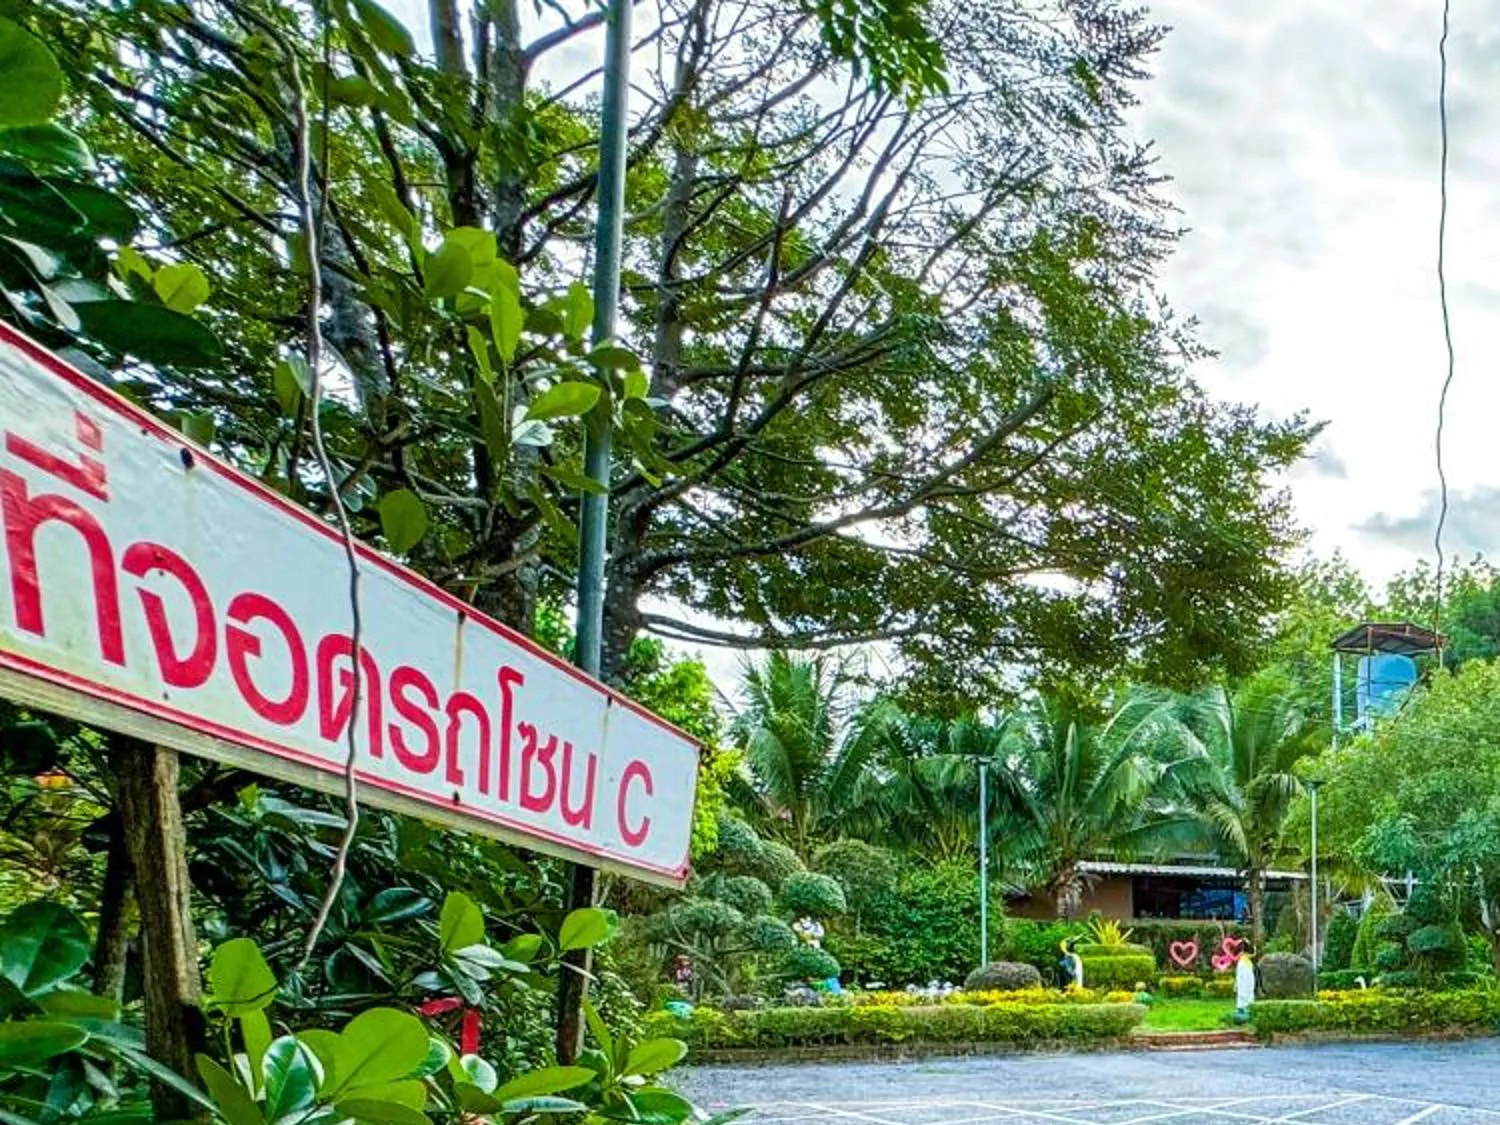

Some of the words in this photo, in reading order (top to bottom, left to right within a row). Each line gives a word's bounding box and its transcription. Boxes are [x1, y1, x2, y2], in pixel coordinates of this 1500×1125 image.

[0, 408, 597, 831] ที่จอดรถโซน
[617, 759, 654, 848] C
